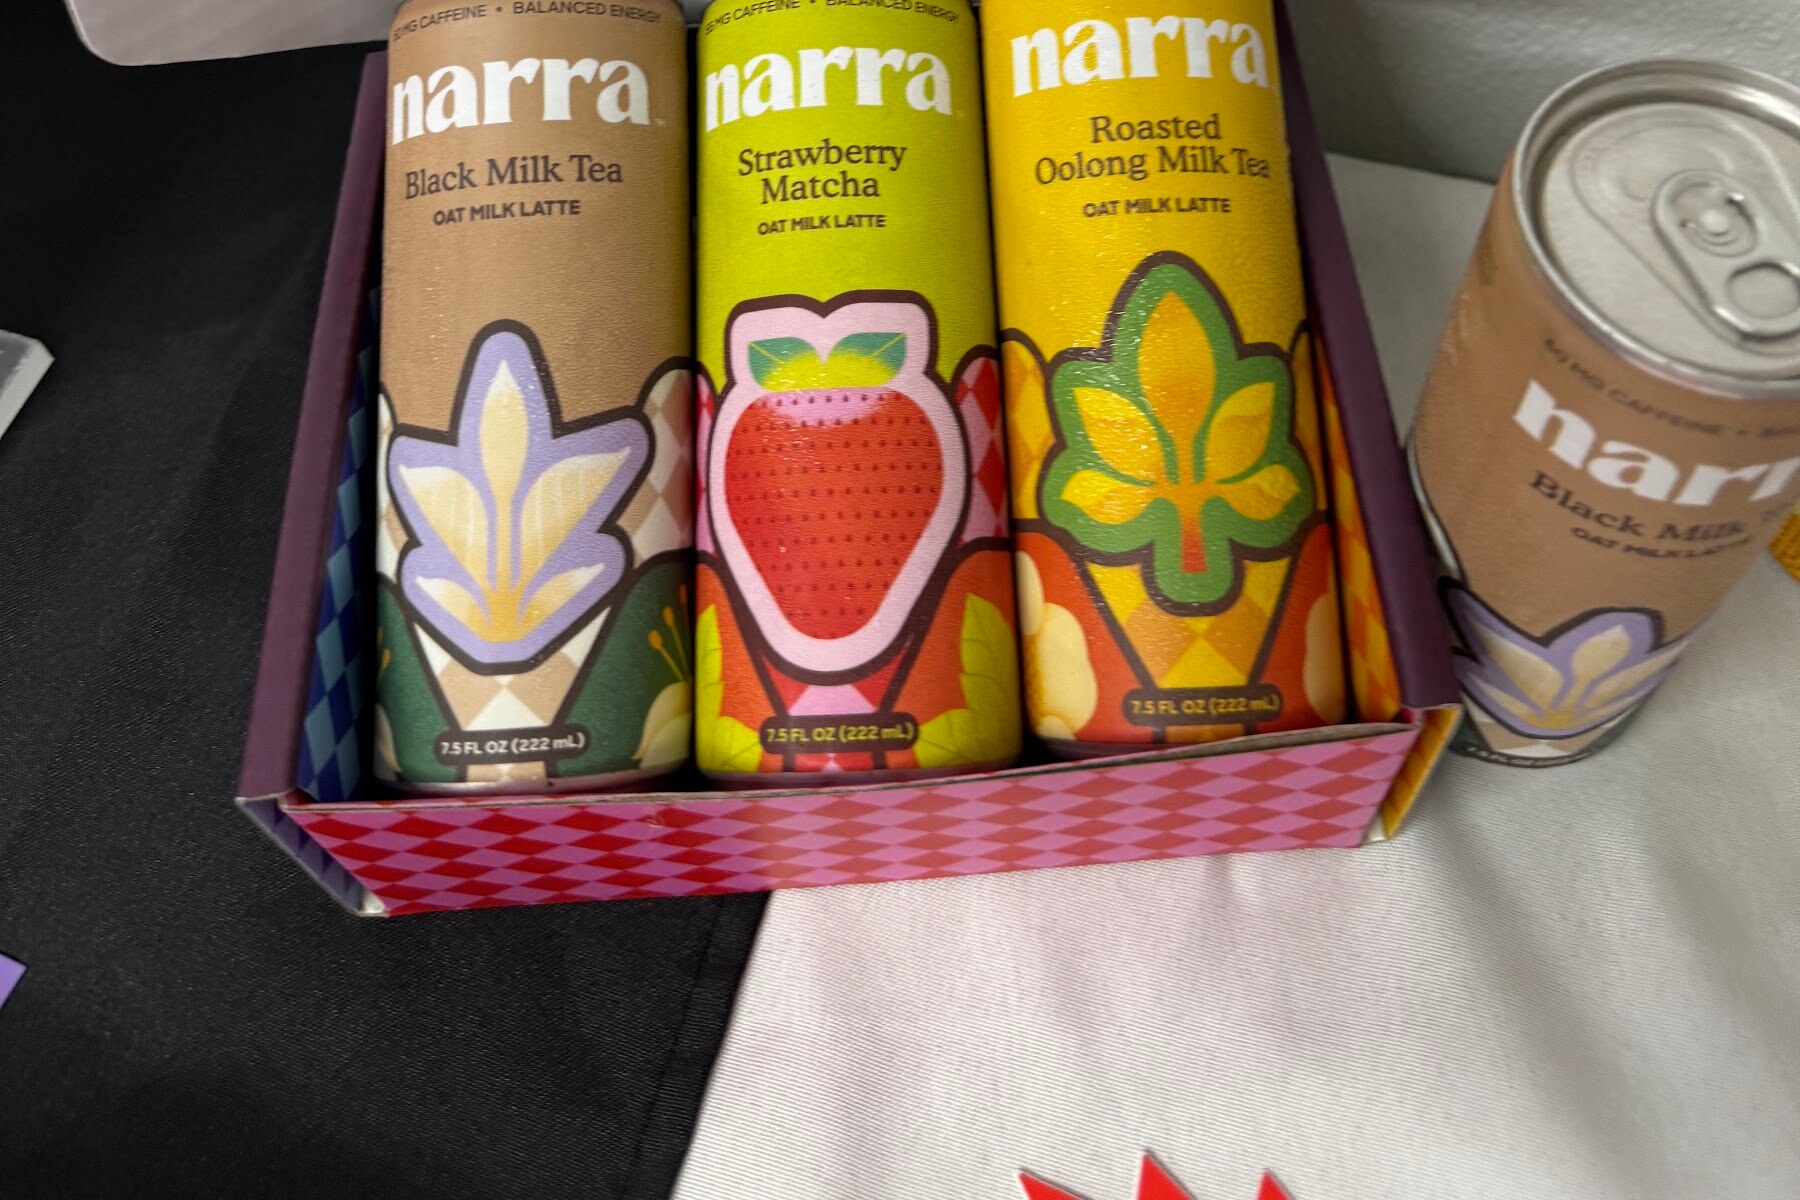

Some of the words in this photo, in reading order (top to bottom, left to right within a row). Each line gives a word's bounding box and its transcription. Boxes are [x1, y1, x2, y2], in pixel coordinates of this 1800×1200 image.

[420, 4, 488, 29] CAFFEINE
[513, 1, 607, 17] BALANCED
[1010, 15, 1269, 98] narra
[391, 57, 650, 146] narra
[705, 46, 953, 133] narra
[1090, 113, 1222, 144] Roasted
[738, 138, 908, 177] Strawberry
[1035, 152, 1149, 185] Oolong
[1158, 146, 1229, 174] Milk
[1233, 148, 1271, 179] Tea
[404, 161, 477, 200] Black
[486, 155, 564, 186] Milk
[569, 154, 623, 183] Tea
[761, 170, 880, 205] Matcha
[433, 207, 465, 226] OAT
[470, 202, 515, 221] MILK
[520, 200, 581, 217] LATTE
[1083, 199, 1119, 218] OAT
[1125, 197, 1171, 215] MILK
[1175, 197, 1232, 214] LATTE
[757, 220, 786, 236] OAT
[790, 216, 831, 231] MILK
[834, 214, 887, 228] LATTE
[1530, 470, 1646, 538] Black
[1130, 700, 1156, 715] 7.5
[1180, 699, 1207, 714] OZ
[1208, 696, 1248, 716] (222
[440, 741, 462, 756] 7.5
[463, 741, 483, 754] FL
[484, 740, 509, 753] OZ
[510, 737, 550, 754] (222
[552, 732, 586, 749] mL)
[766, 728, 788, 743] 7.5
[789, 728, 810, 742] FL
[812, 727, 836, 741] OZ
[838, 724, 879, 743] (222
